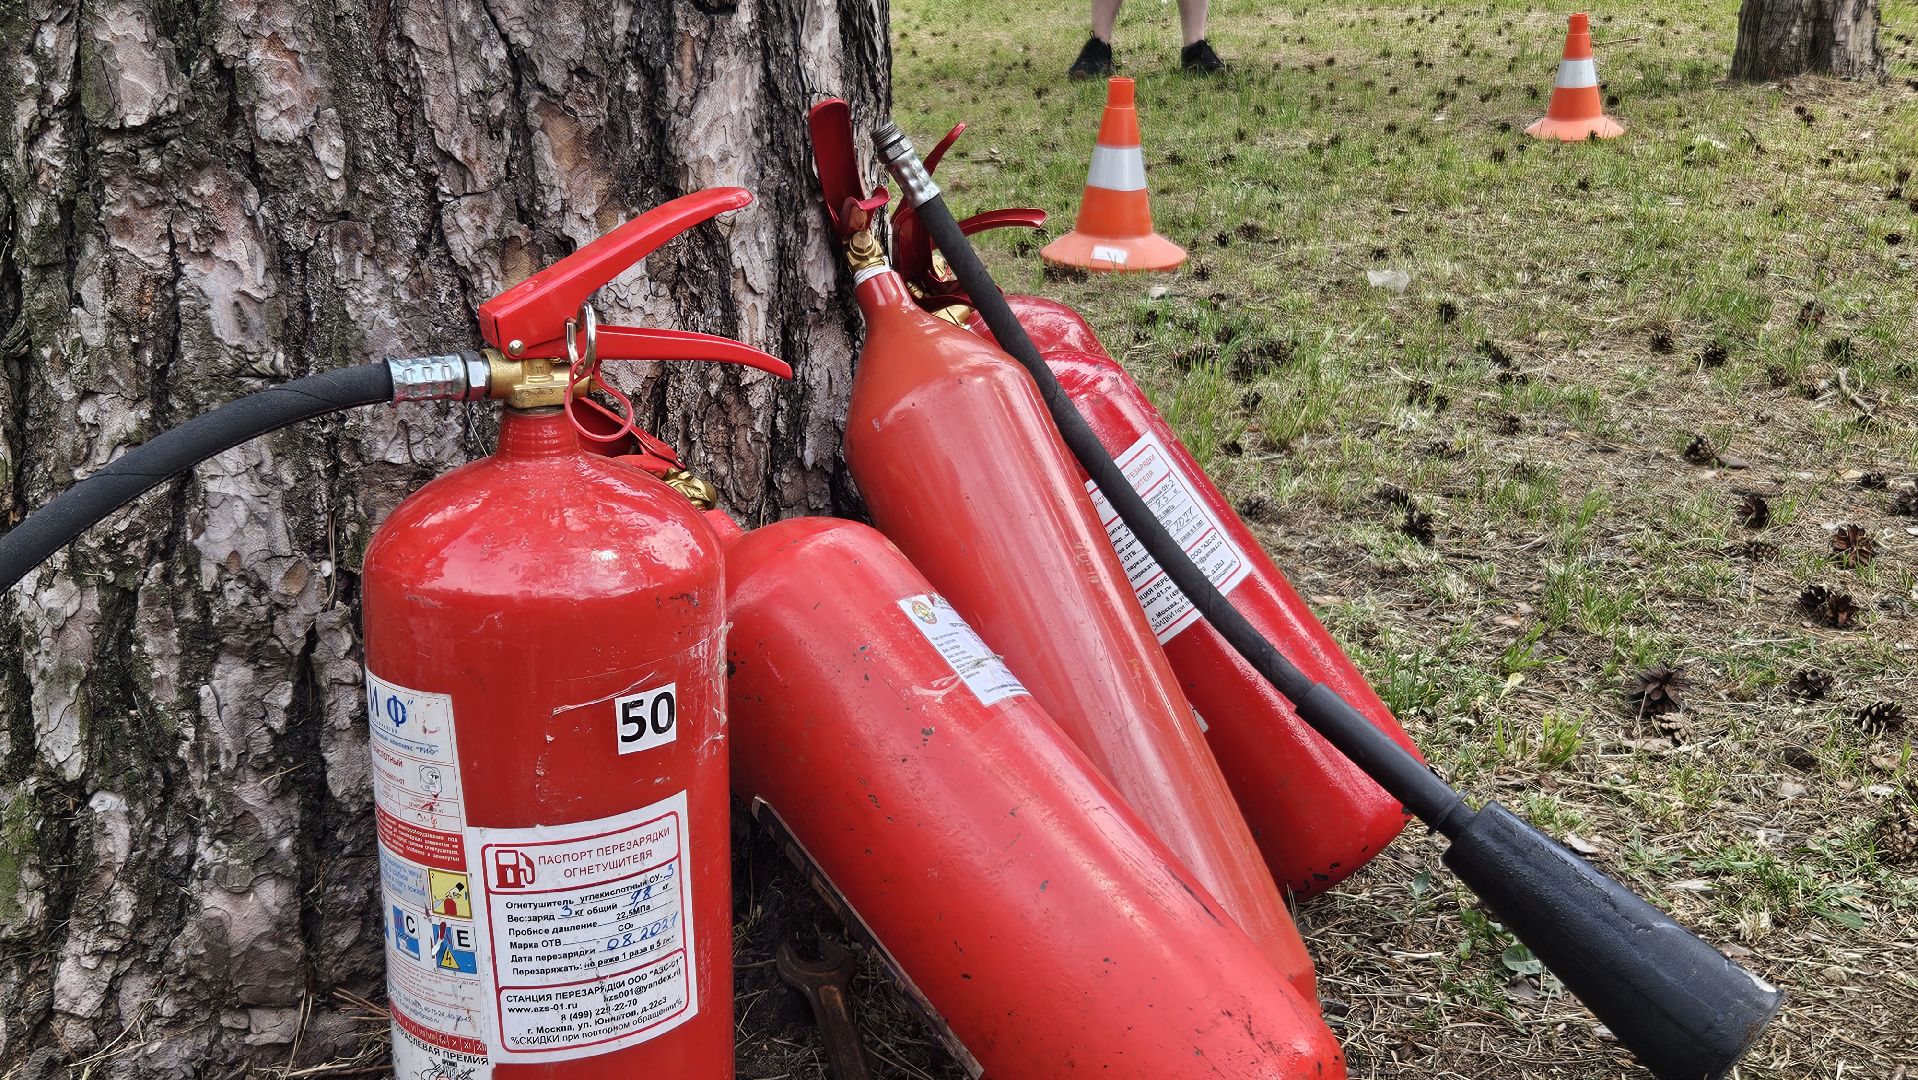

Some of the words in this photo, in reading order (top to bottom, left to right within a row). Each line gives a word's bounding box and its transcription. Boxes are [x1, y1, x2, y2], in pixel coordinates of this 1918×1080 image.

[621, 691, 675, 743] 50
[538, 849, 593, 865] ПАСПОРТ
[597, 827, 670, 857] ПЕРЕЗАРЯДКИ
[564, 849, 653, 878] ОГНЕТУШИТЕЛЯ
[506, 899, 574, 910] Огнетушитель
[580, 879, 647, 904] углекислотный
[587, 903, 618, 915] общий
[508, 928, 550, 937] Пробное
[552, 921, 598, 934] давление
[510, 942, 539, 950] Марка
[541, 939, 562, 948] ОТВ
[511, 954, 533, 963] Дата
[535, 948, 596, 962] перезарядки
[512, 963, 583, 976] Перезаряжать:
[629, 947, 648, 959] раза
[506, 993, 552, 1003] СТАНЦИЯ
[555, 980, 626, 1000] ПЕРЕЗАРЯДКИ
[628, 973, 648, 985] ООО
[649, 956, 683, 978] "АЗС-01"
[507, 1002, 578, 1013] www.azs-01.ru
[560, 1014, 567, 1022] 8
[569, 1009, 592, 1021] (499)
[511, 1030, 560, 1045] %СКИДКИ
[562, 1033, 580, 1043] при
[582, 1022, 630, 1038] повторном
[536, 1023, 575, 1034] Москва,
[577, 1021, 592, 1031] ул.
[442, 1050, 489, 1066] ПРЕМИЯ
